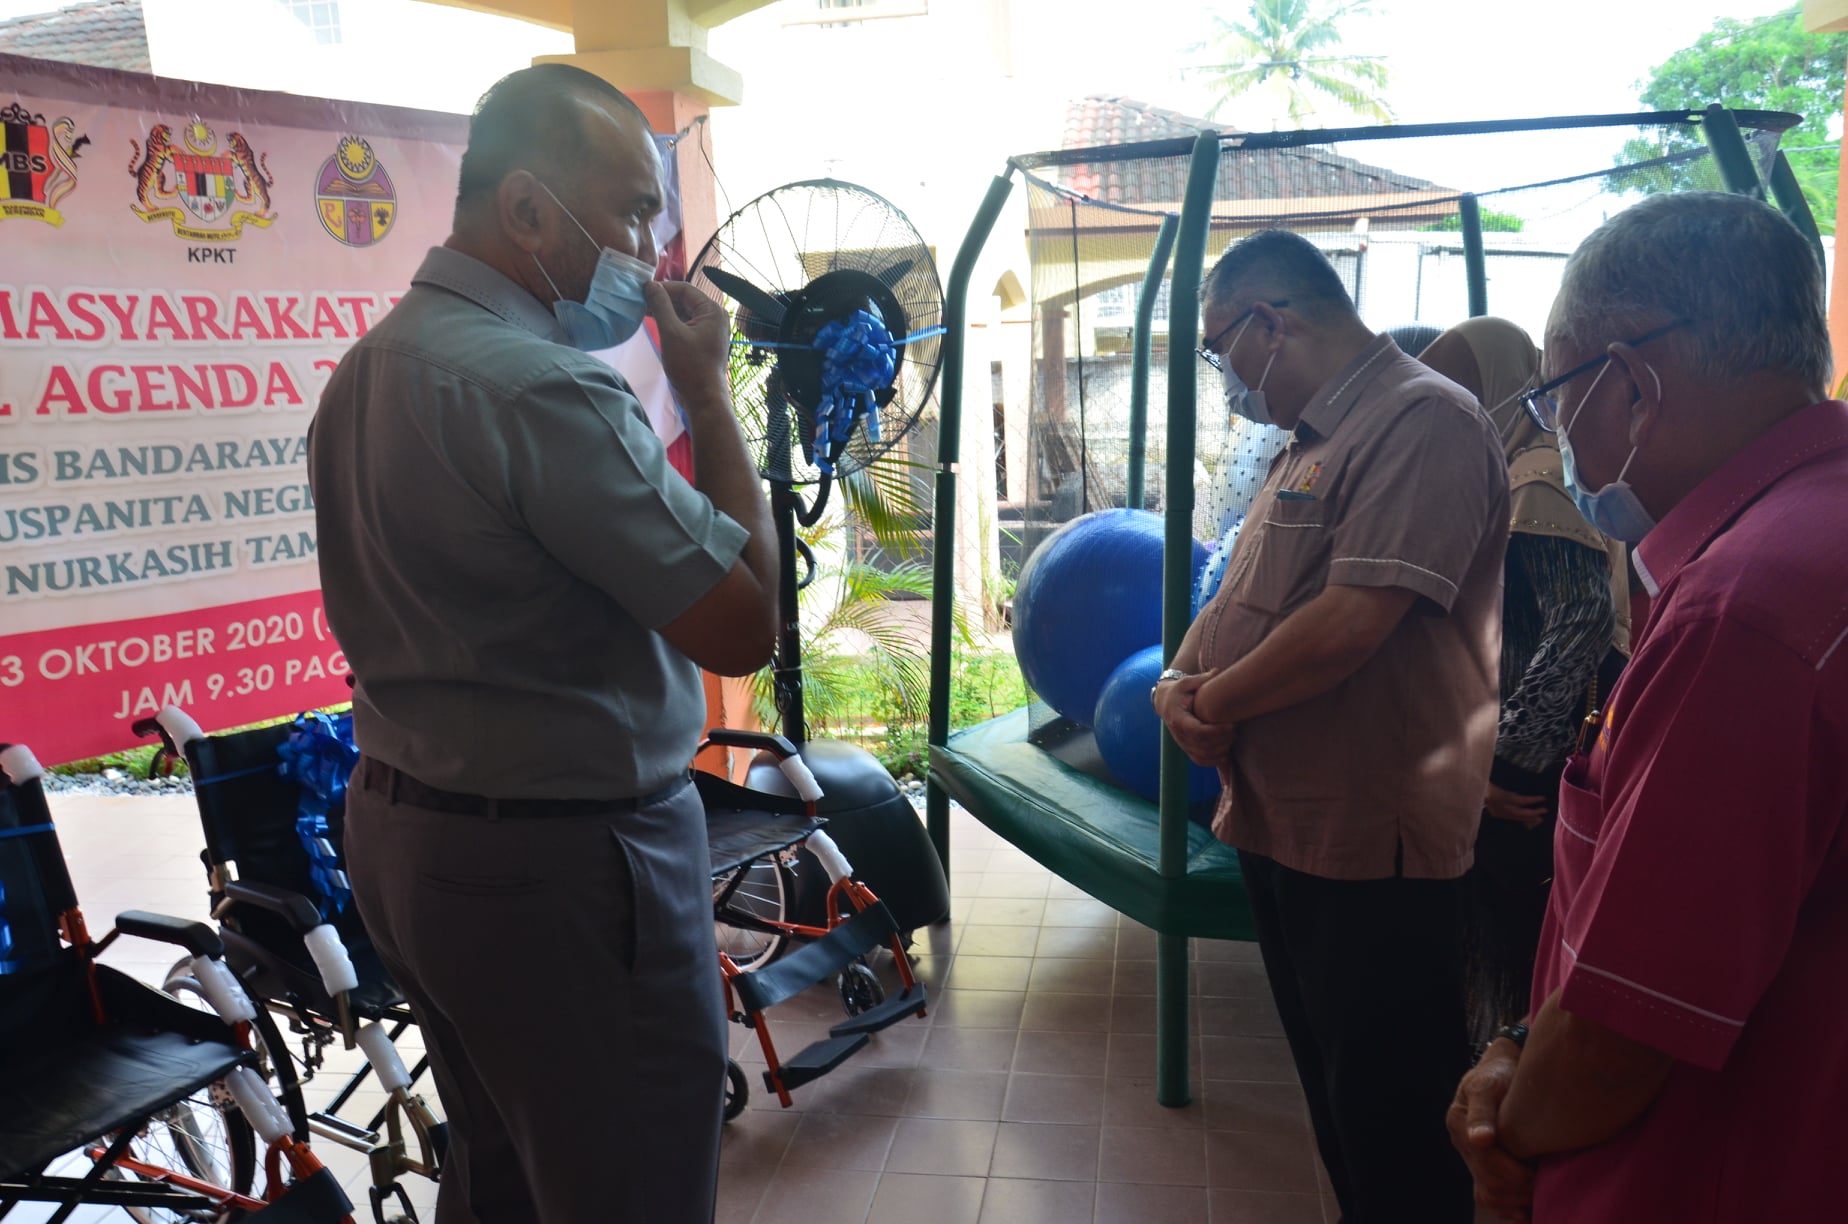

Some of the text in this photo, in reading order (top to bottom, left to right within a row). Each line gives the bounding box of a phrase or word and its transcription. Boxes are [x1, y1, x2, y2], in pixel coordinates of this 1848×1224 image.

[188, 247, 237, 263] KPKT
[36, 359, 303, 415] AGENDA
[54, 436, 308, 481] BANDARAYA
[6, 540, 233, 595] NURKASIH
[38, 627, 216, 680] OKTOBER
[226, 611, 304, 651] 2020
[113, 679, 194, 719] JAM
[206, 663, 275, 700] 9.30
